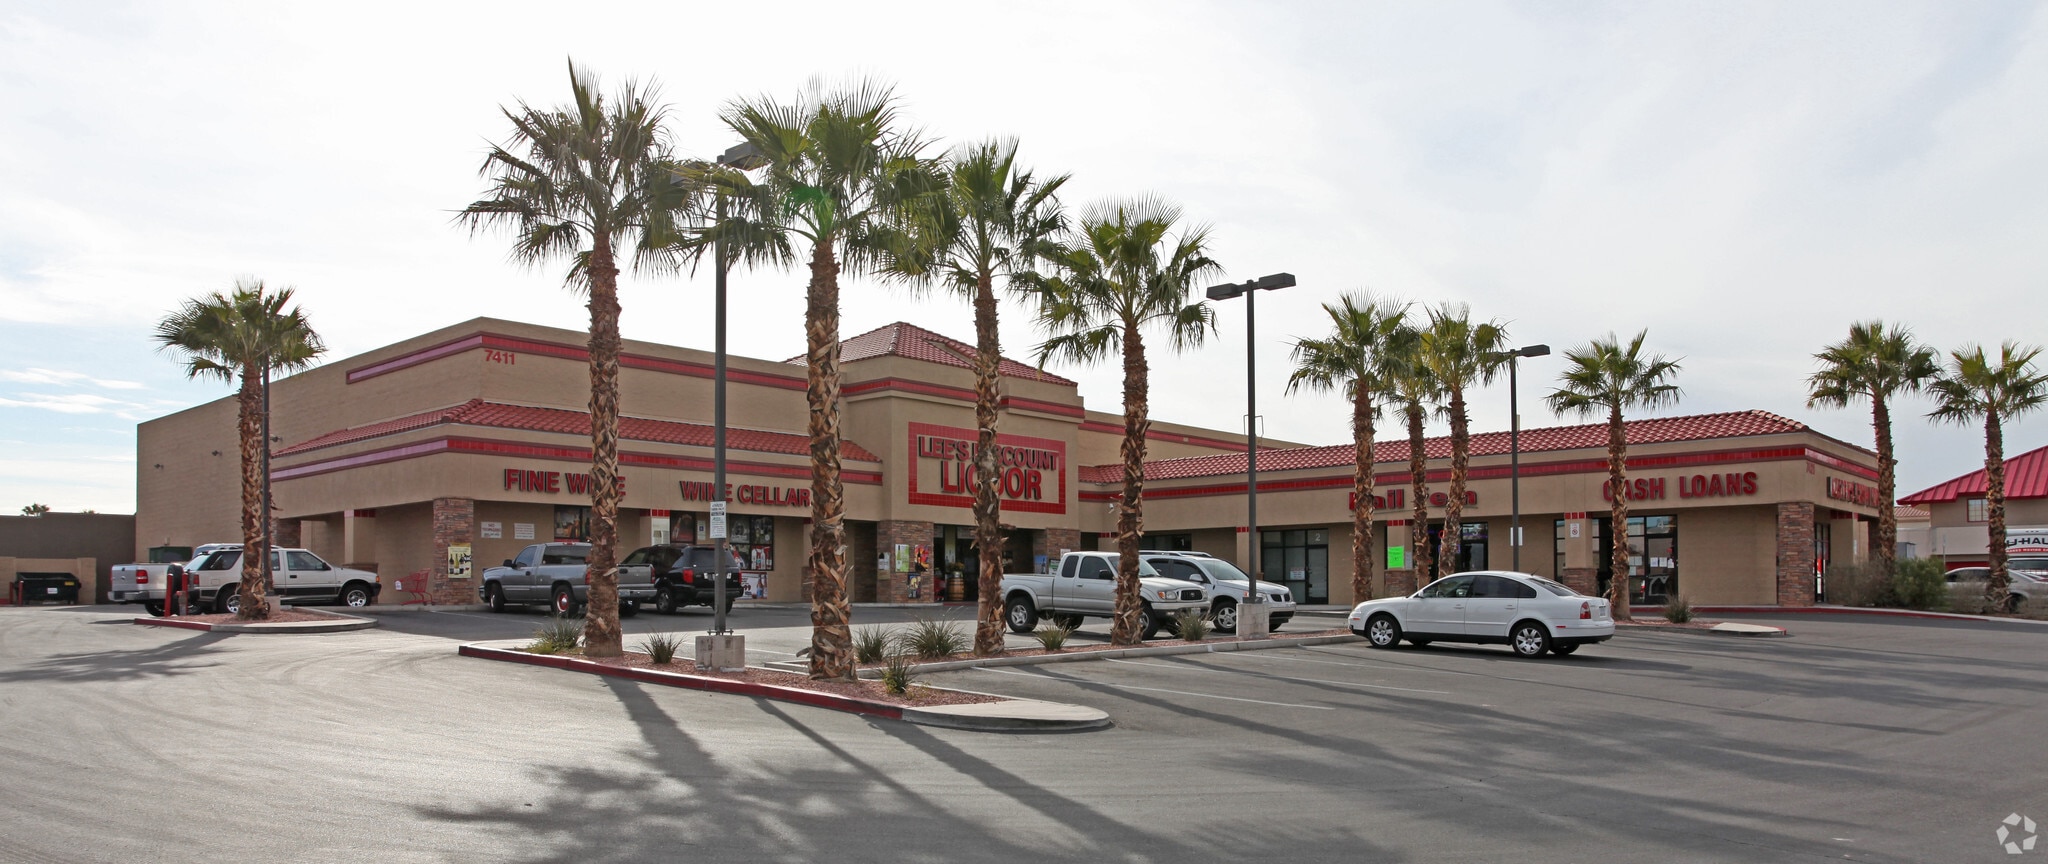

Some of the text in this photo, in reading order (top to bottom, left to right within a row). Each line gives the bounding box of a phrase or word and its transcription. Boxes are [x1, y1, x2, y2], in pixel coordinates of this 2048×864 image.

[485, 349, 515, 365] 7411
[919, 436, 1059, 471] LEE'S COUNT
[504, 468, 626, 501] FINE WIE
[738, 484, 811, 507] CELLAR
[1603, 471, 1758, 502] CASH LOANS
[1315, 532, 1321, 542] 2
